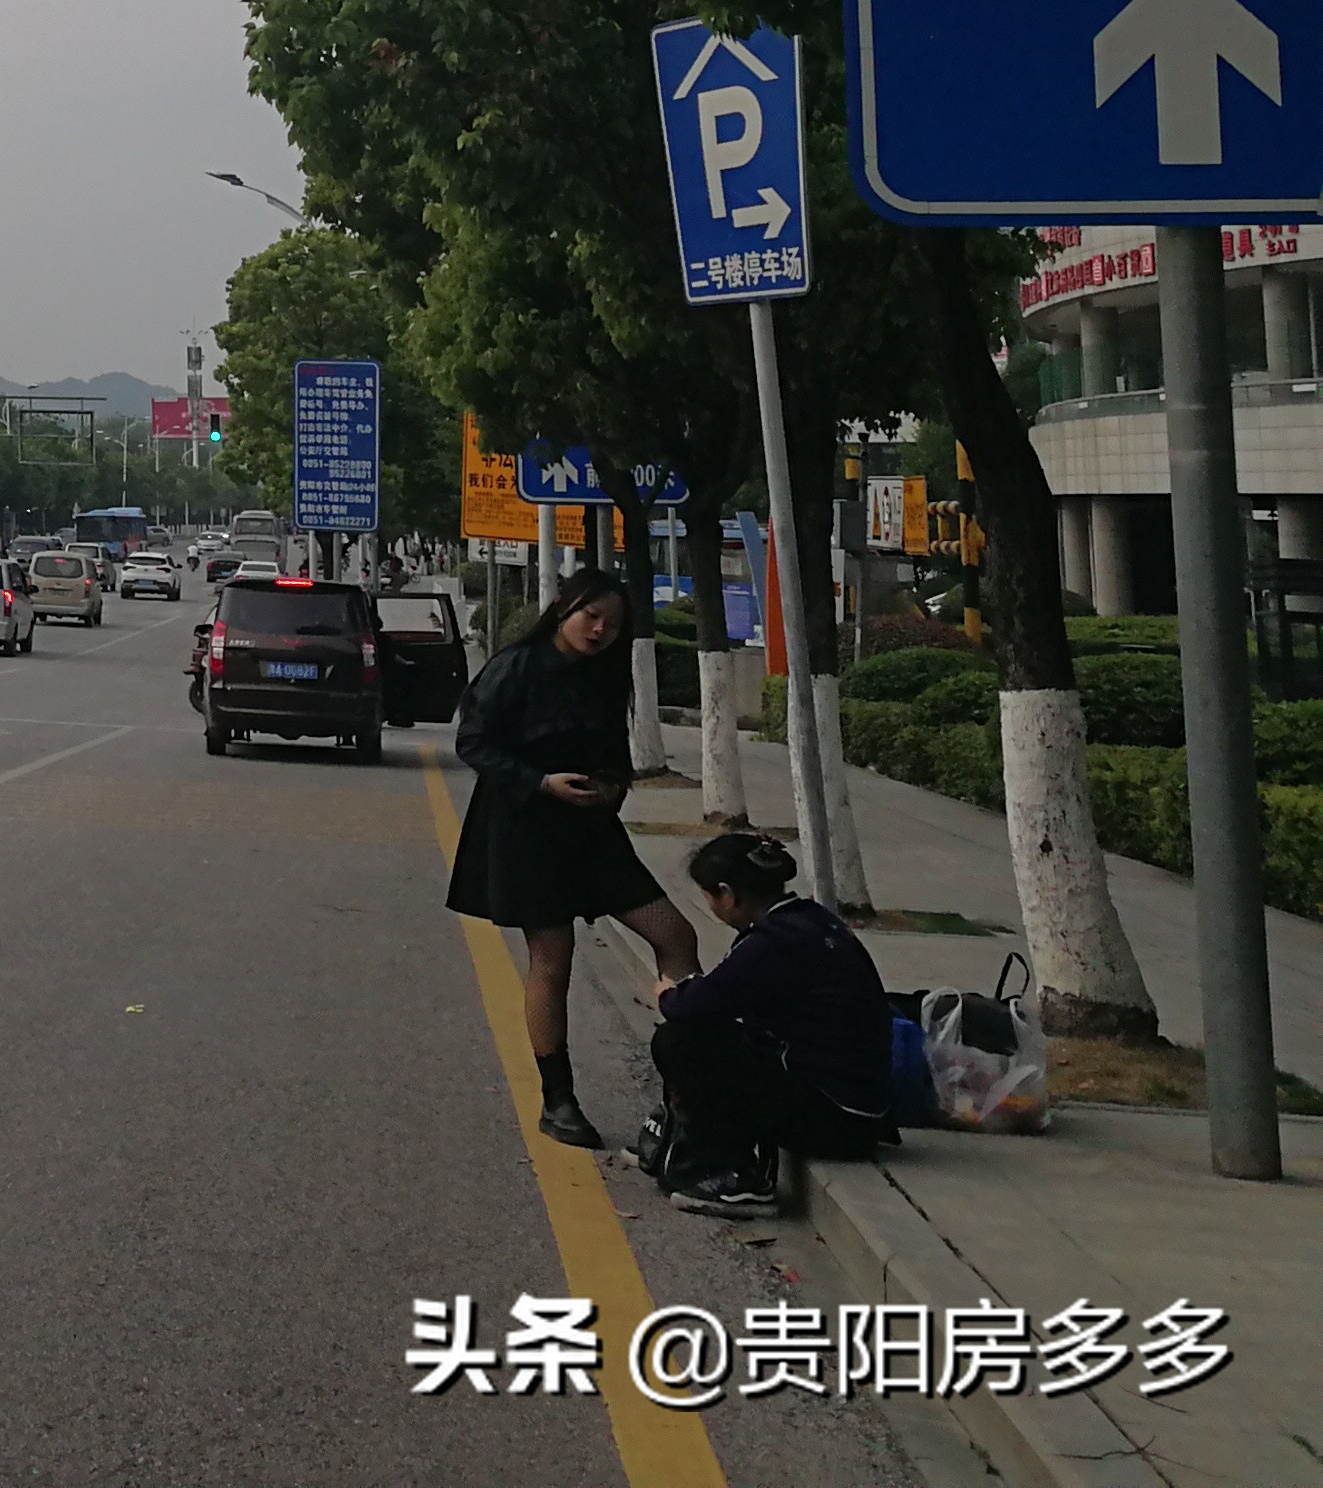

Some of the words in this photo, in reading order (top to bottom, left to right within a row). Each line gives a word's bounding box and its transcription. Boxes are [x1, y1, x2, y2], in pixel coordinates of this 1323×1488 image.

[690, 247, 803, 291] 二号楼停车场
